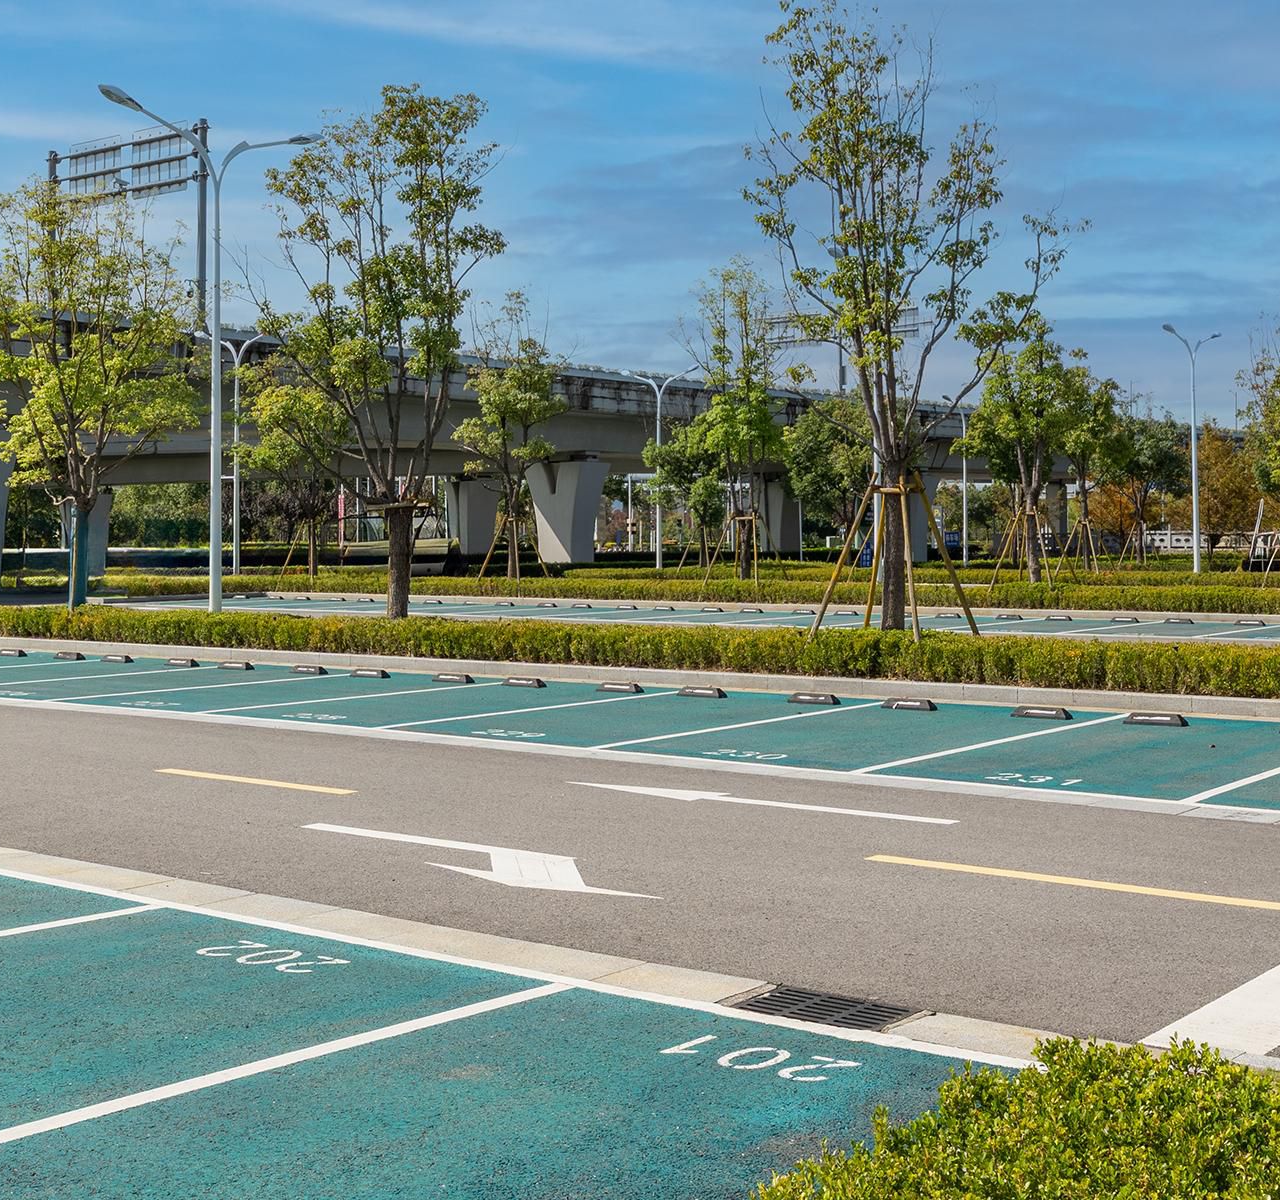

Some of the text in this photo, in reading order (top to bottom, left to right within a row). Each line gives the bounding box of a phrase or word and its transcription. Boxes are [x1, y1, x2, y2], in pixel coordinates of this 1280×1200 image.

[702, 748, 788, 760] 230
[984, 772, 1083, 786] 231
[195, 940, 352, 973] 202
[659, 1034, 863, 1082] 201
